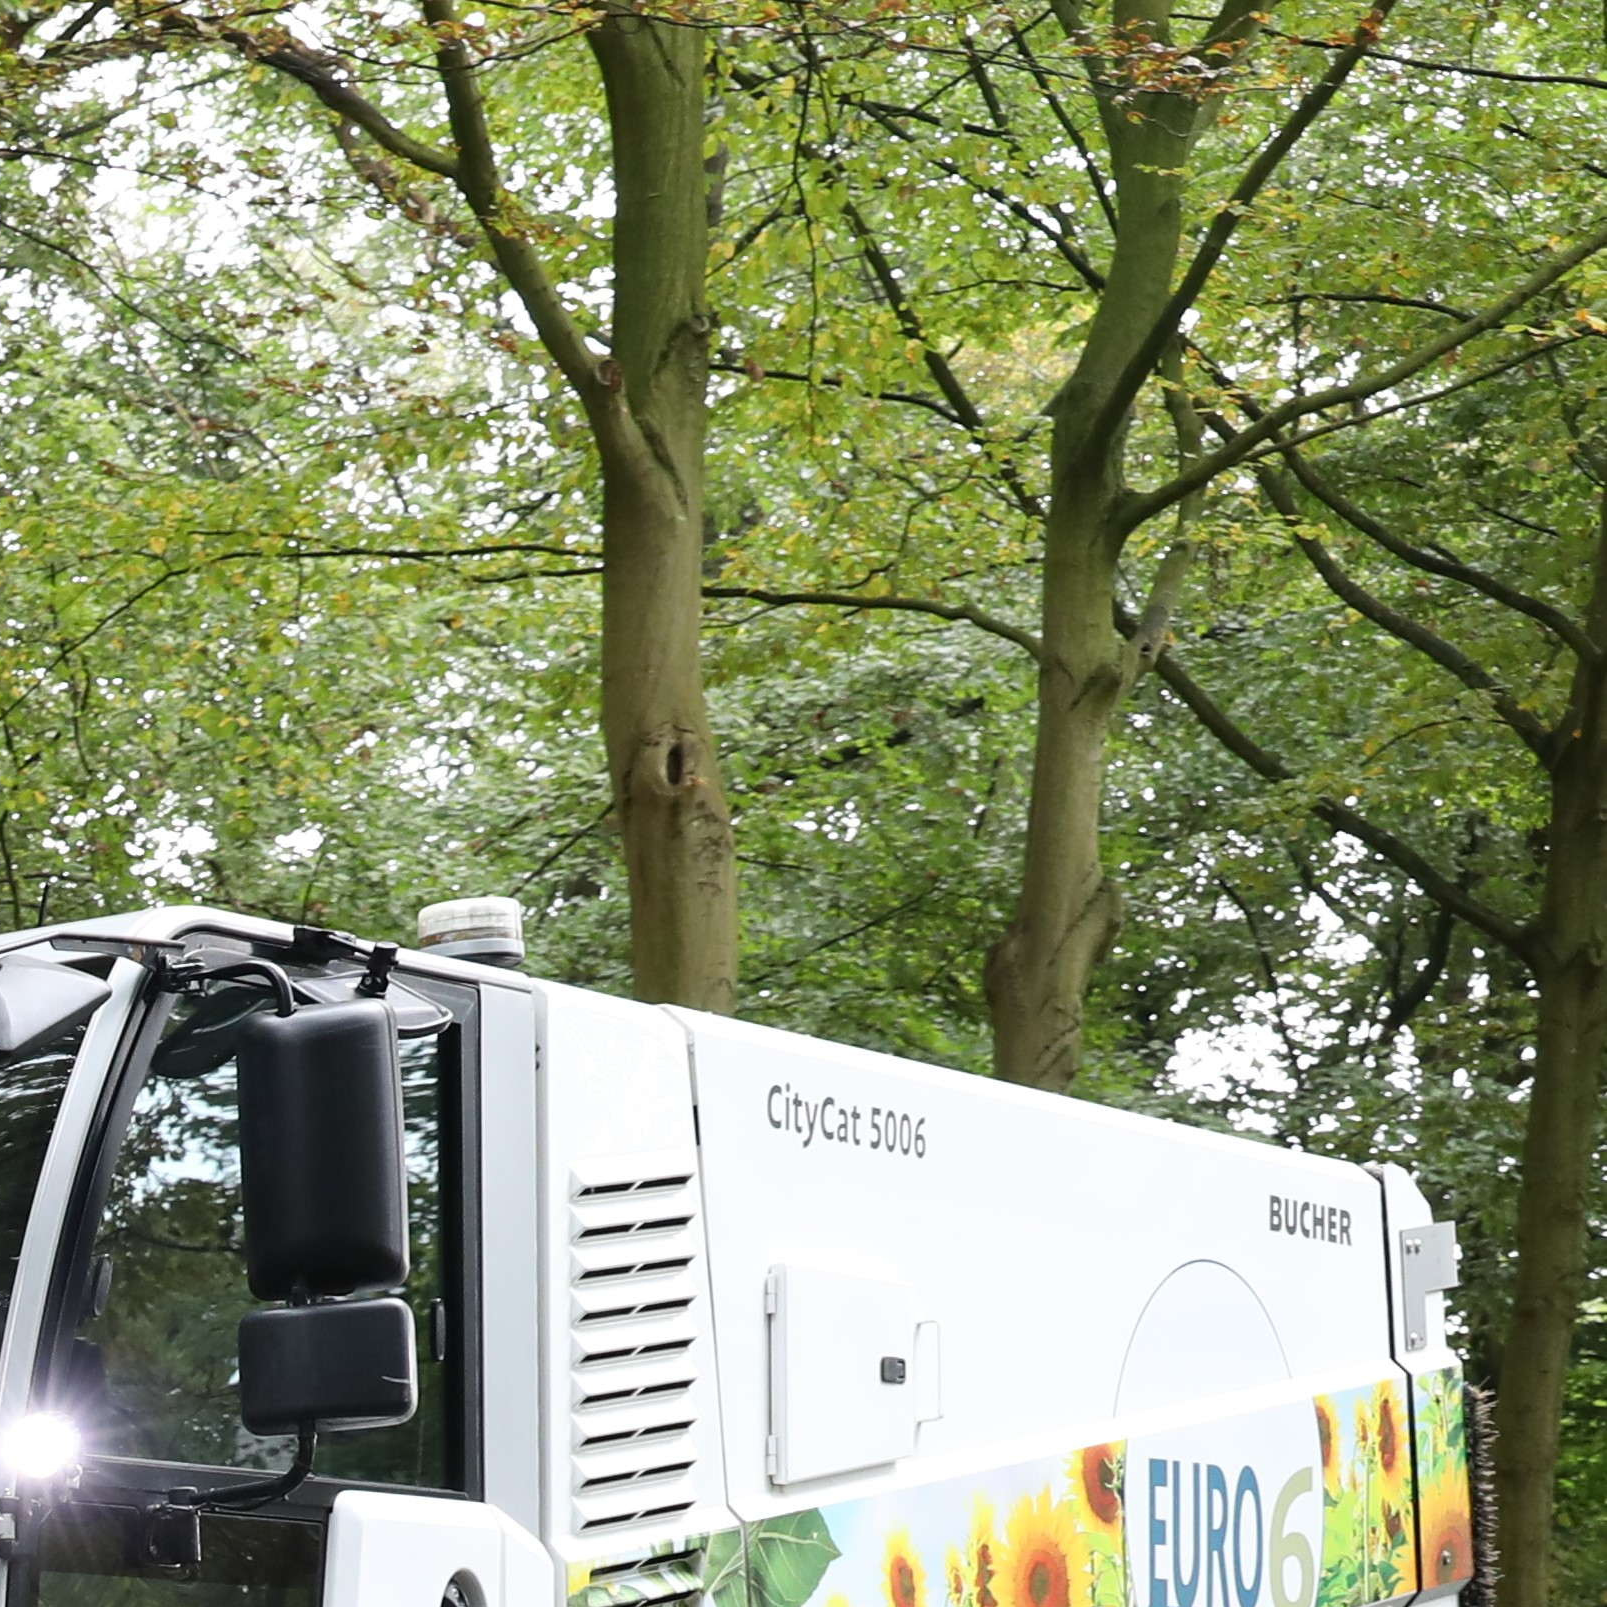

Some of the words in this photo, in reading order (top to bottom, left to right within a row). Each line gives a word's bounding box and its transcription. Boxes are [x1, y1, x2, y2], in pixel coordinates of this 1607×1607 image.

[767, 1082, 861, 1148] CityCat
[870, 1107, 926, 1159] 5006
[1269, 1194, 1352, 1247] BUCHER
